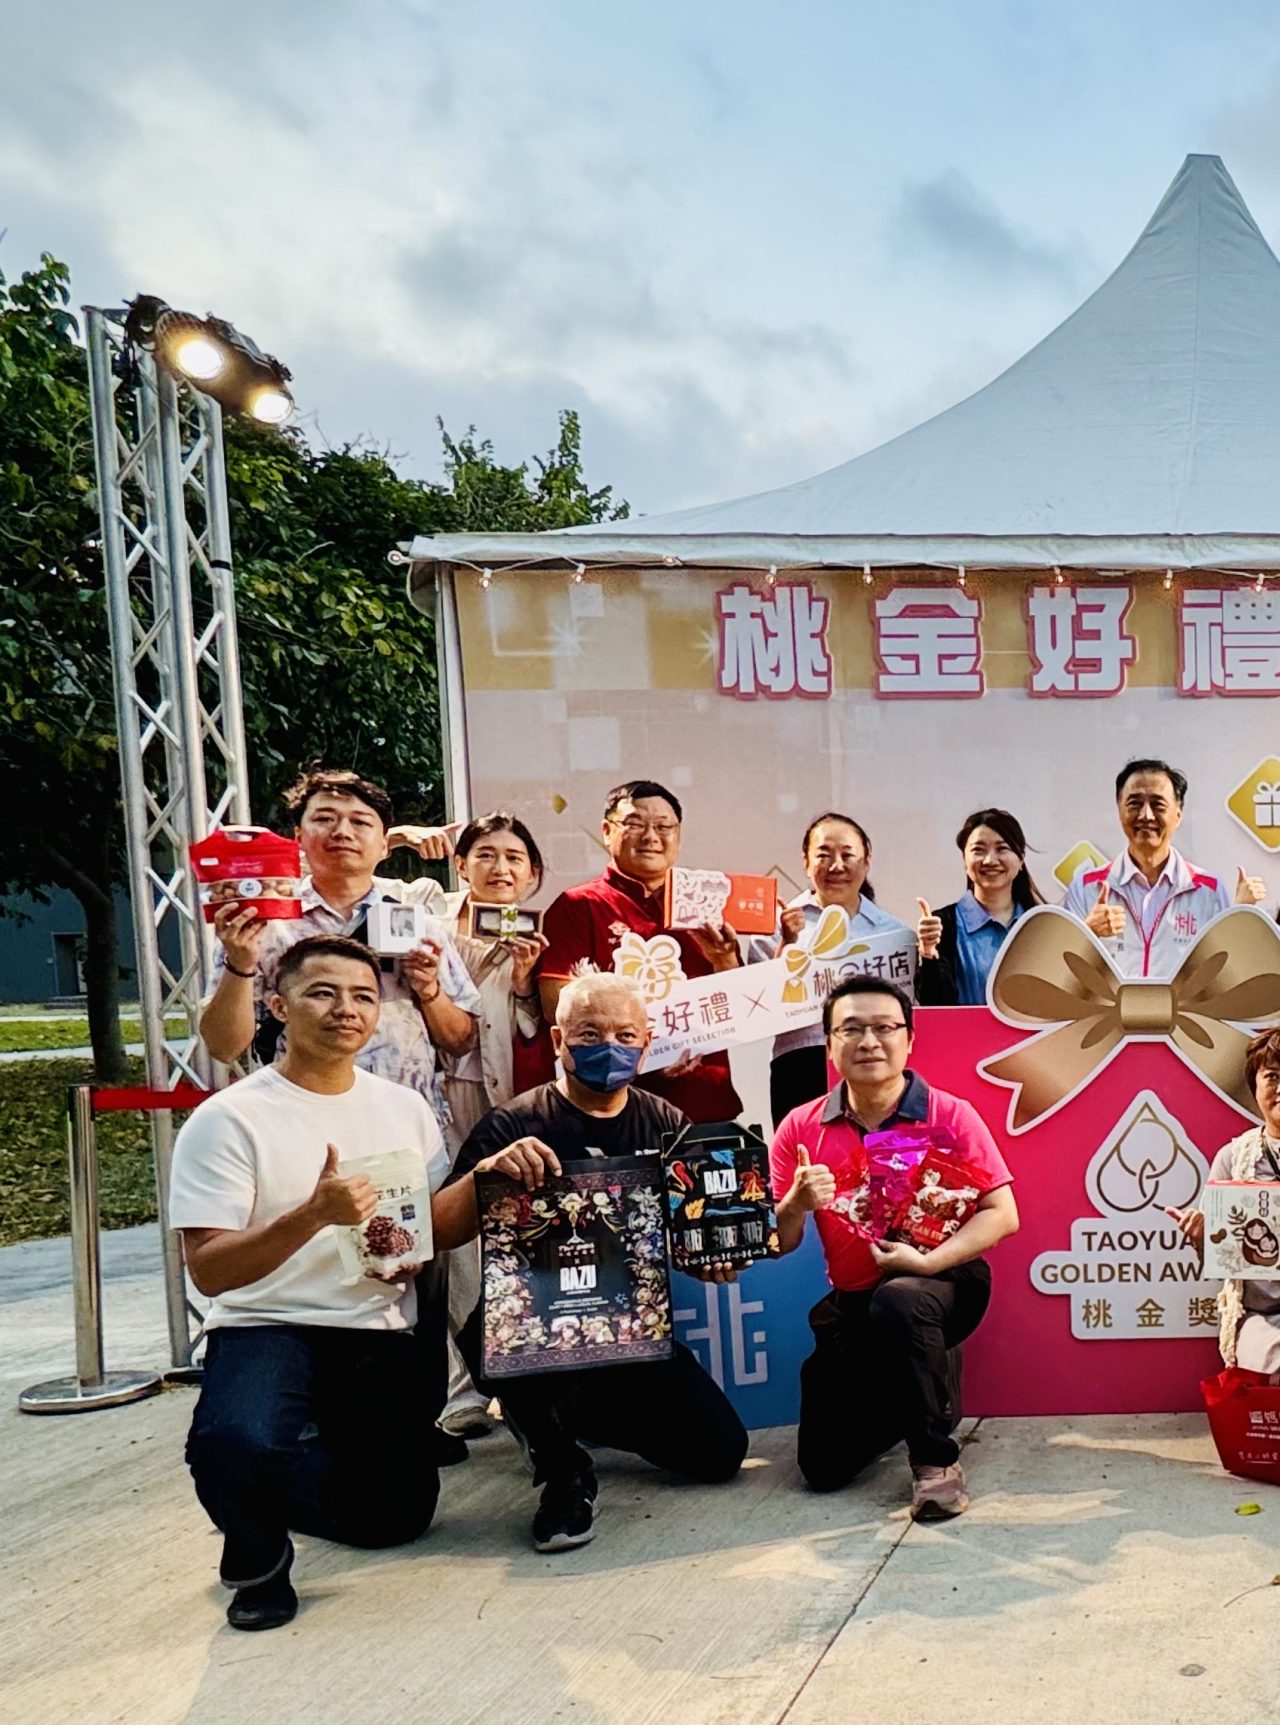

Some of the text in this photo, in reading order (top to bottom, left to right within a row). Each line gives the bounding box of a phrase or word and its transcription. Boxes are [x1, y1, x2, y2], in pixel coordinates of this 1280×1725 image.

[704, 1169, 737, 1195] BAZU
[1082, 1230, 1195, 1251] TAOYUA
[560, 1265, 597, 1291] BAZU
[1040, 1262, 1151, 1284] GOLDEN
[1082, 1298, 1218, 1328] 桃金獎
